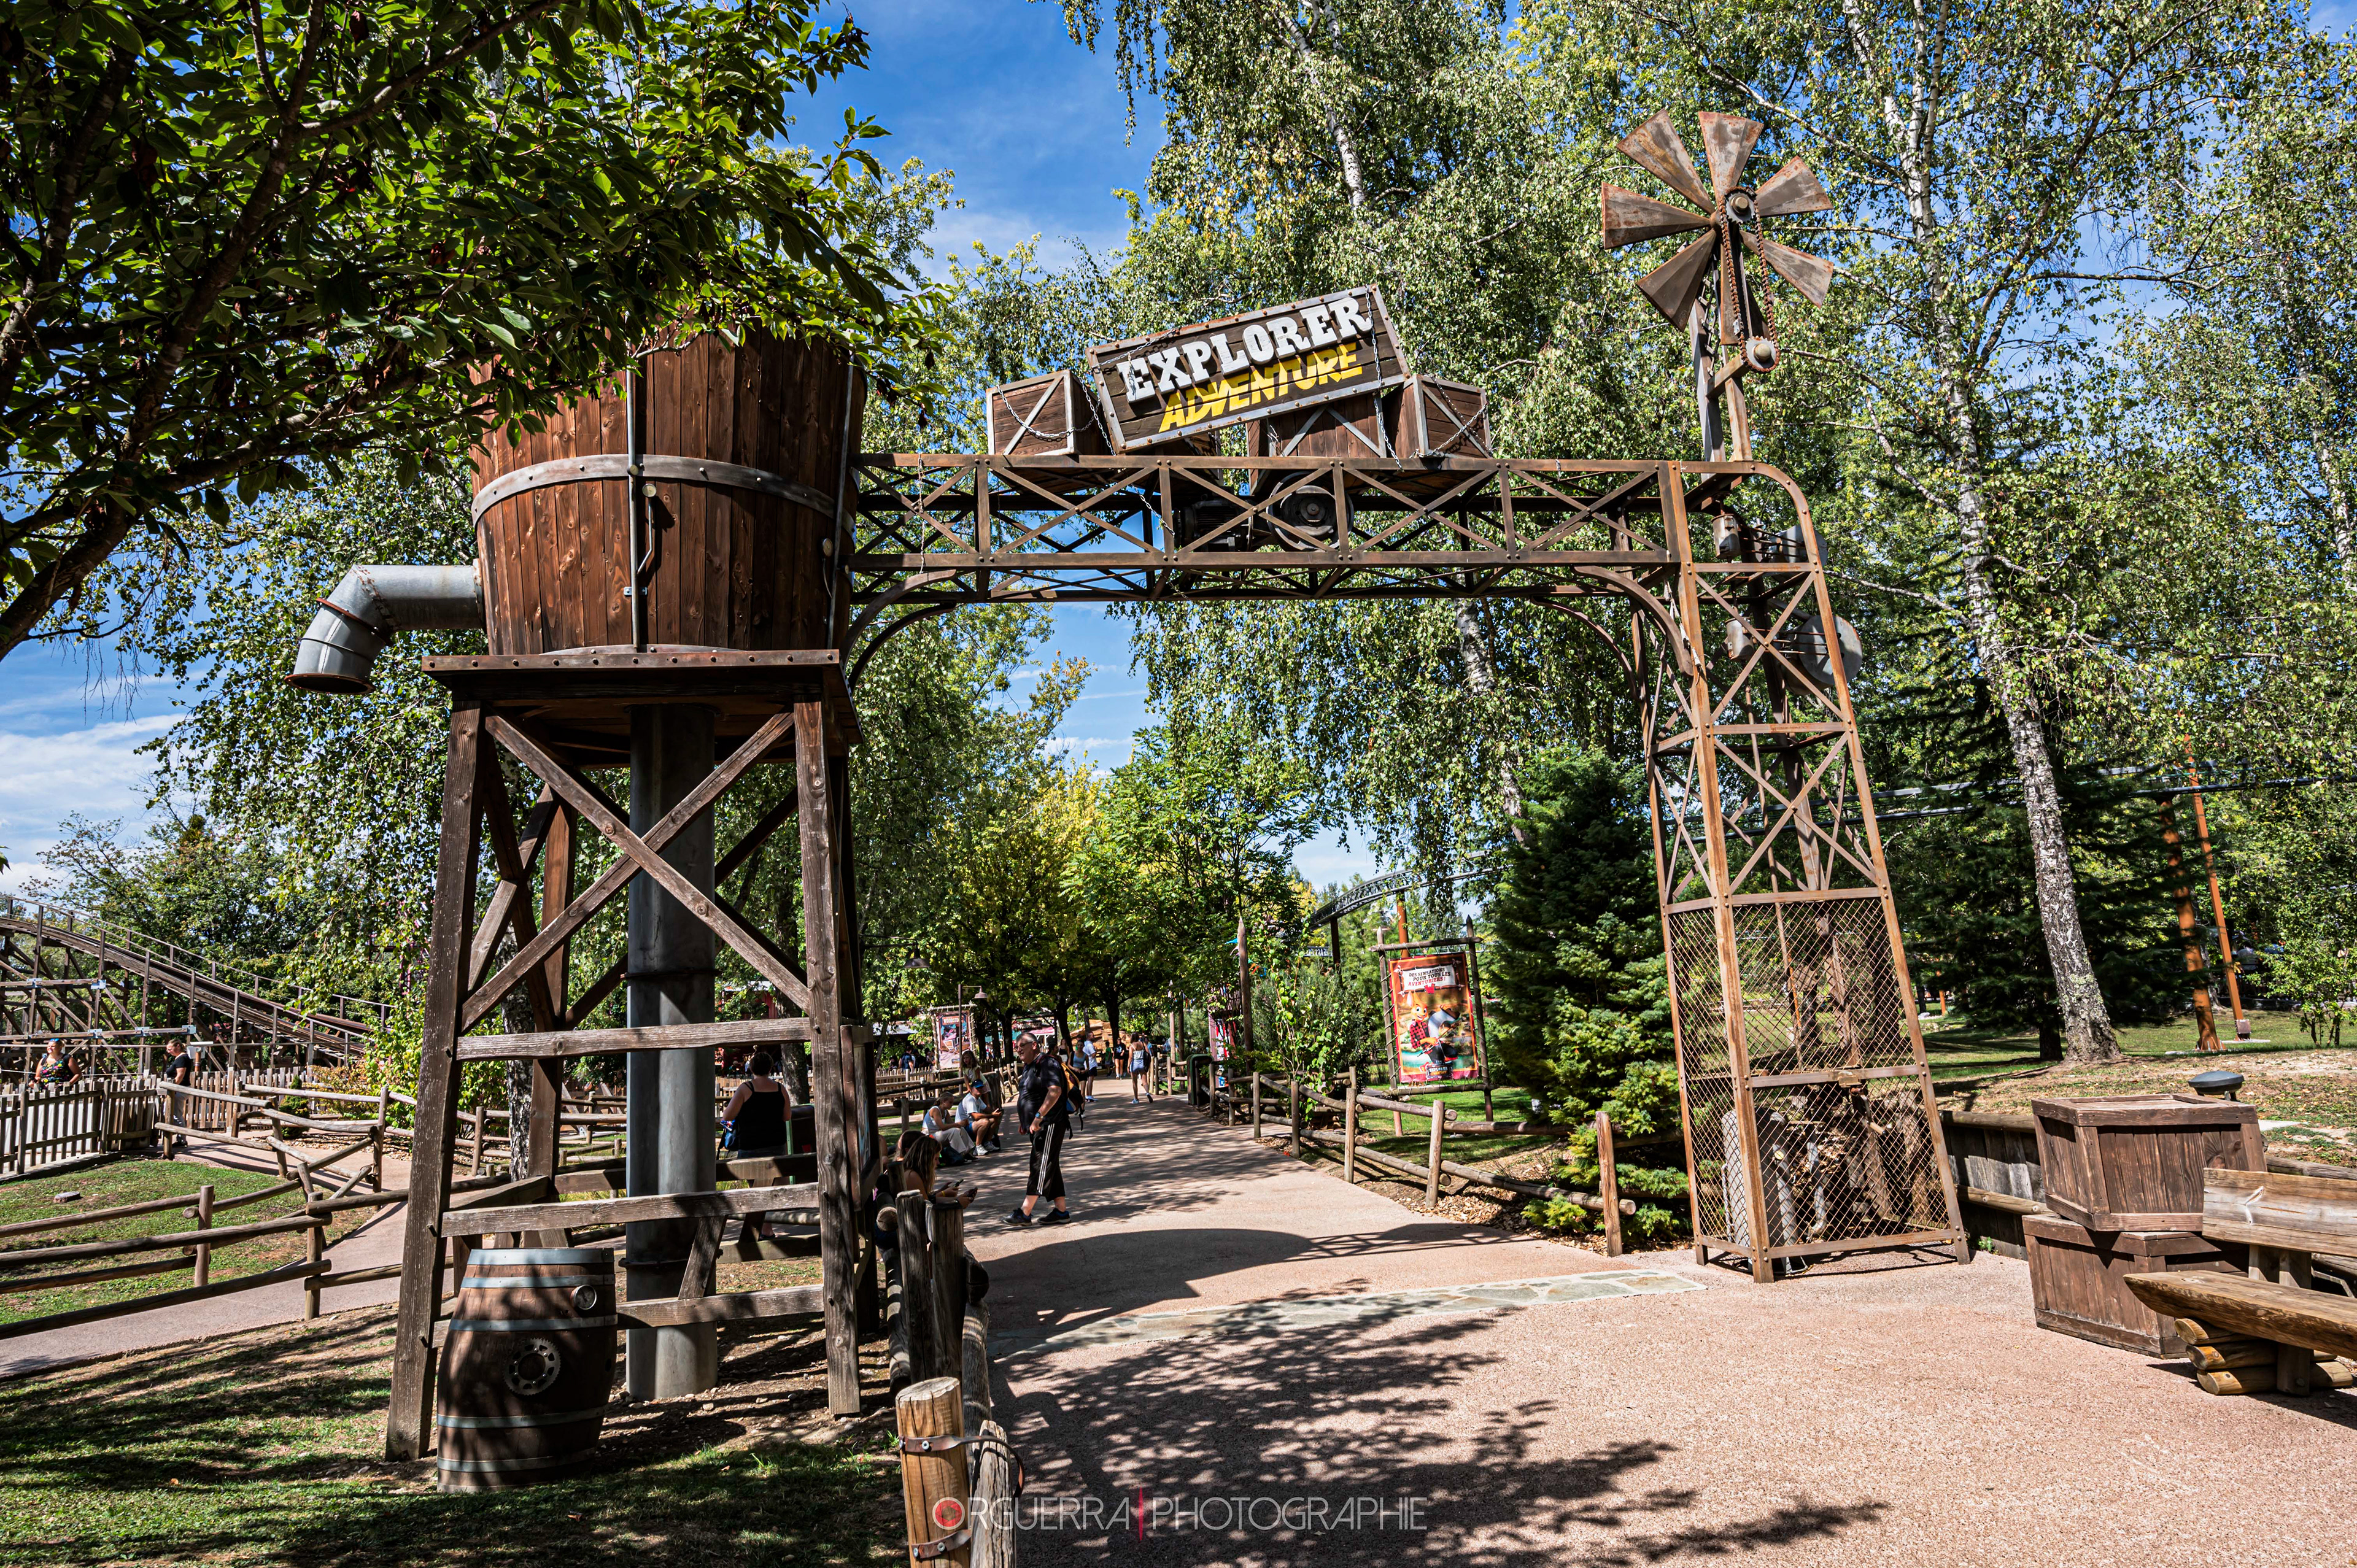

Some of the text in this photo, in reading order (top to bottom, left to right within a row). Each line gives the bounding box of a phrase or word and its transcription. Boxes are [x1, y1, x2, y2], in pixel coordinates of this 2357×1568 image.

[1117, 297, 1373, 403] EXPLORER
[1159, 343, 1363, 433] ADVENTURE
[1418, 967, 1445, 976] SENSATIONS
